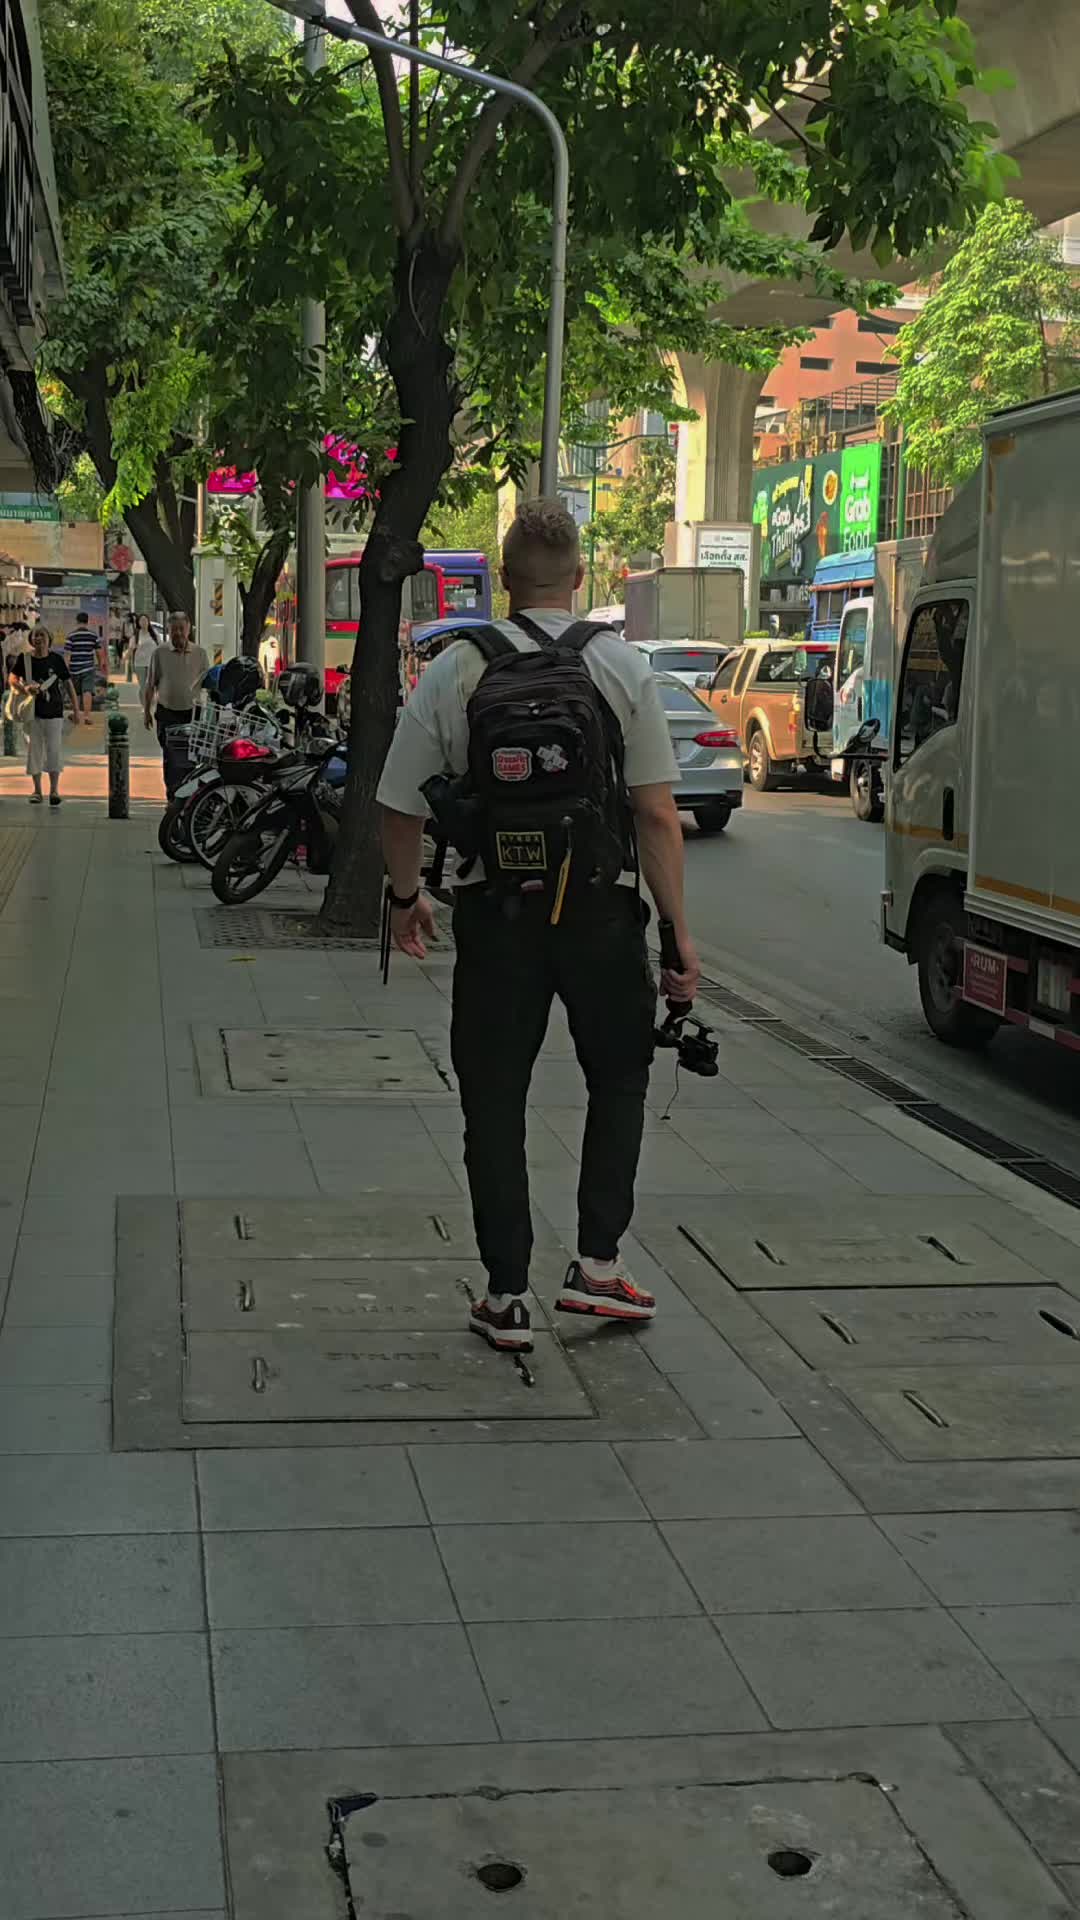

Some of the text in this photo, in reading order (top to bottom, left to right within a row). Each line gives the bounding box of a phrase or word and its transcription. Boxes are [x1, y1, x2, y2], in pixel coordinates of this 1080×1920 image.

[845, 492, 871, 523] Grab
[843, 522, 872, 553] Food
[502, 845, 541, 861] KTW
